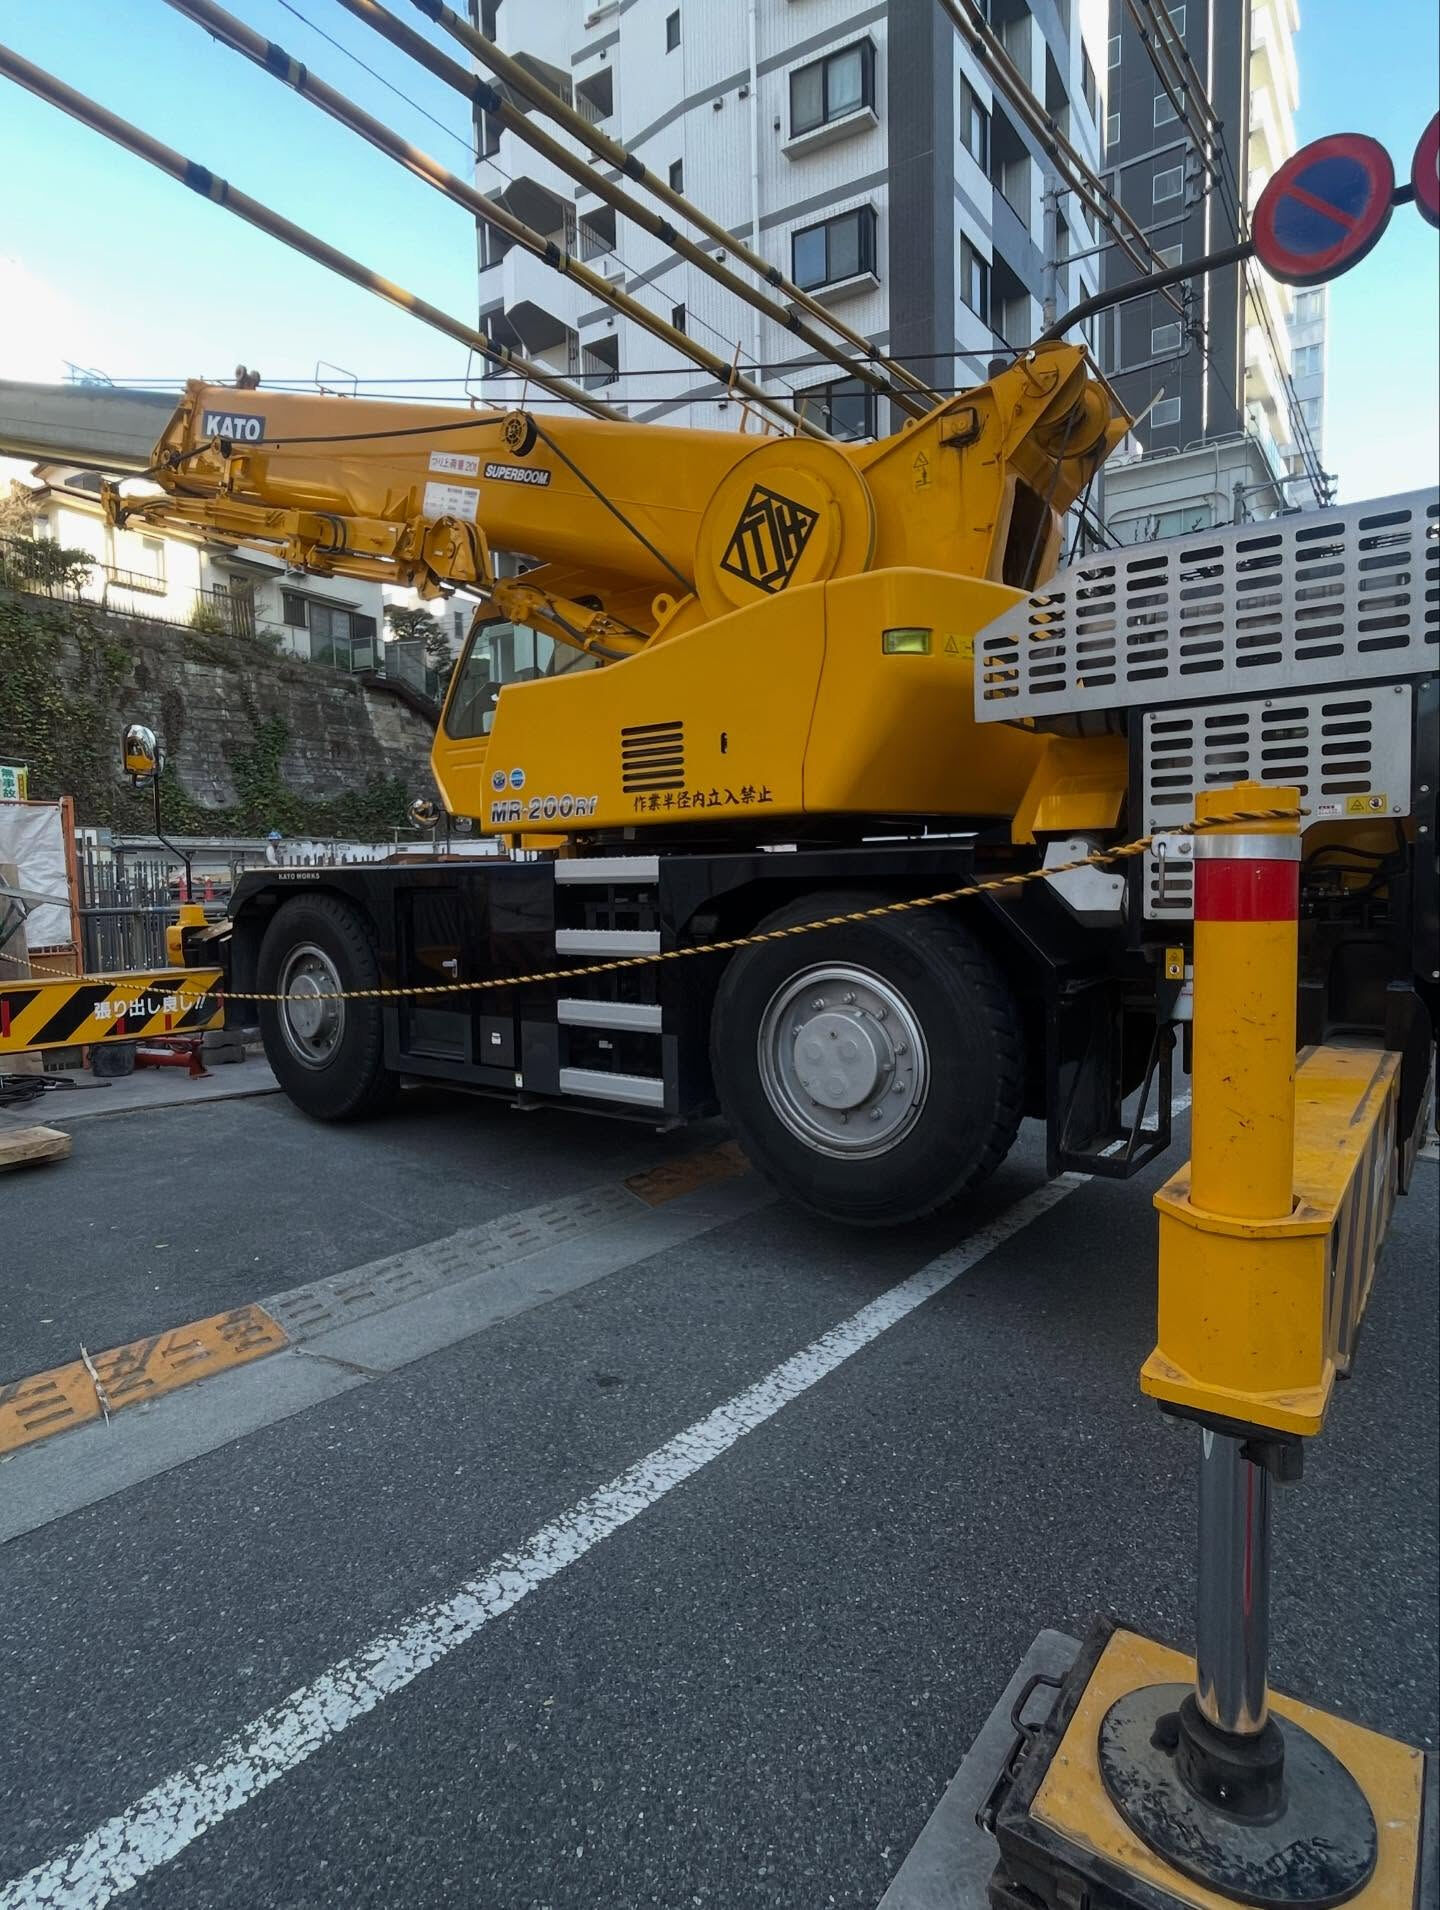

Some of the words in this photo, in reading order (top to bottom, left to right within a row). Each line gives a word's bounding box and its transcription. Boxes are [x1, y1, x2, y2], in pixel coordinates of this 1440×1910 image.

[206, 414, 261, 440] KATO
[485, 464, 549, 485] SUPERBOOM
[633, 785, 773, 813] 作業半径内立入禁止
[278, 872, 296, 880] KATO
[296, 872, 320, 880] WORKS
